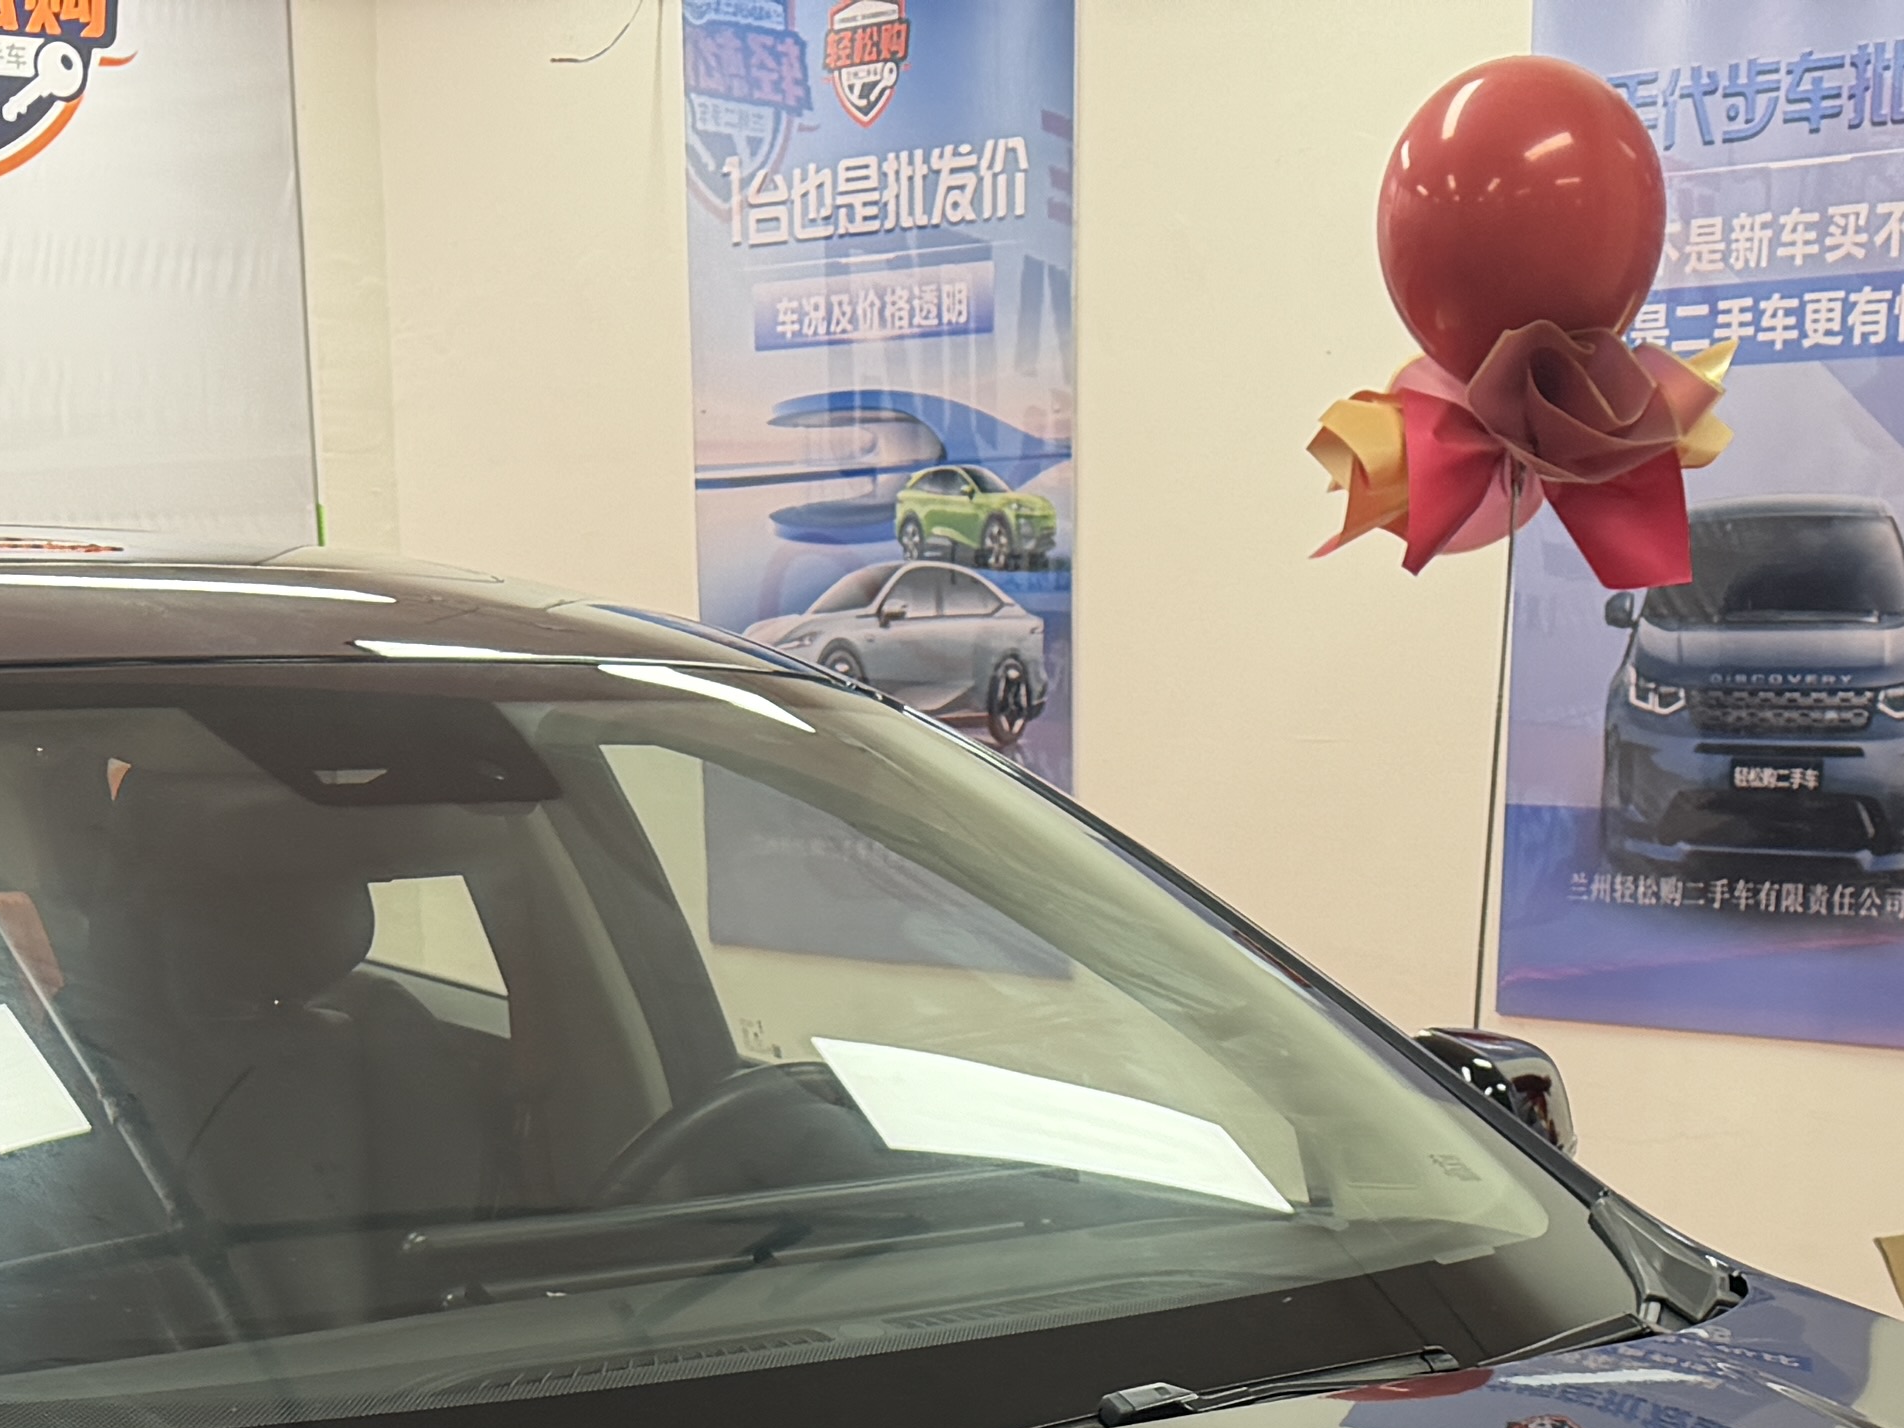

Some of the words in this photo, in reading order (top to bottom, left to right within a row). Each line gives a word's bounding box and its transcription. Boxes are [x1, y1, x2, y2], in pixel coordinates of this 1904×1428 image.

[723, 136, 1028, 246] 1台也是批发价
[776, 281, 968, 340] 车况及价格透明
